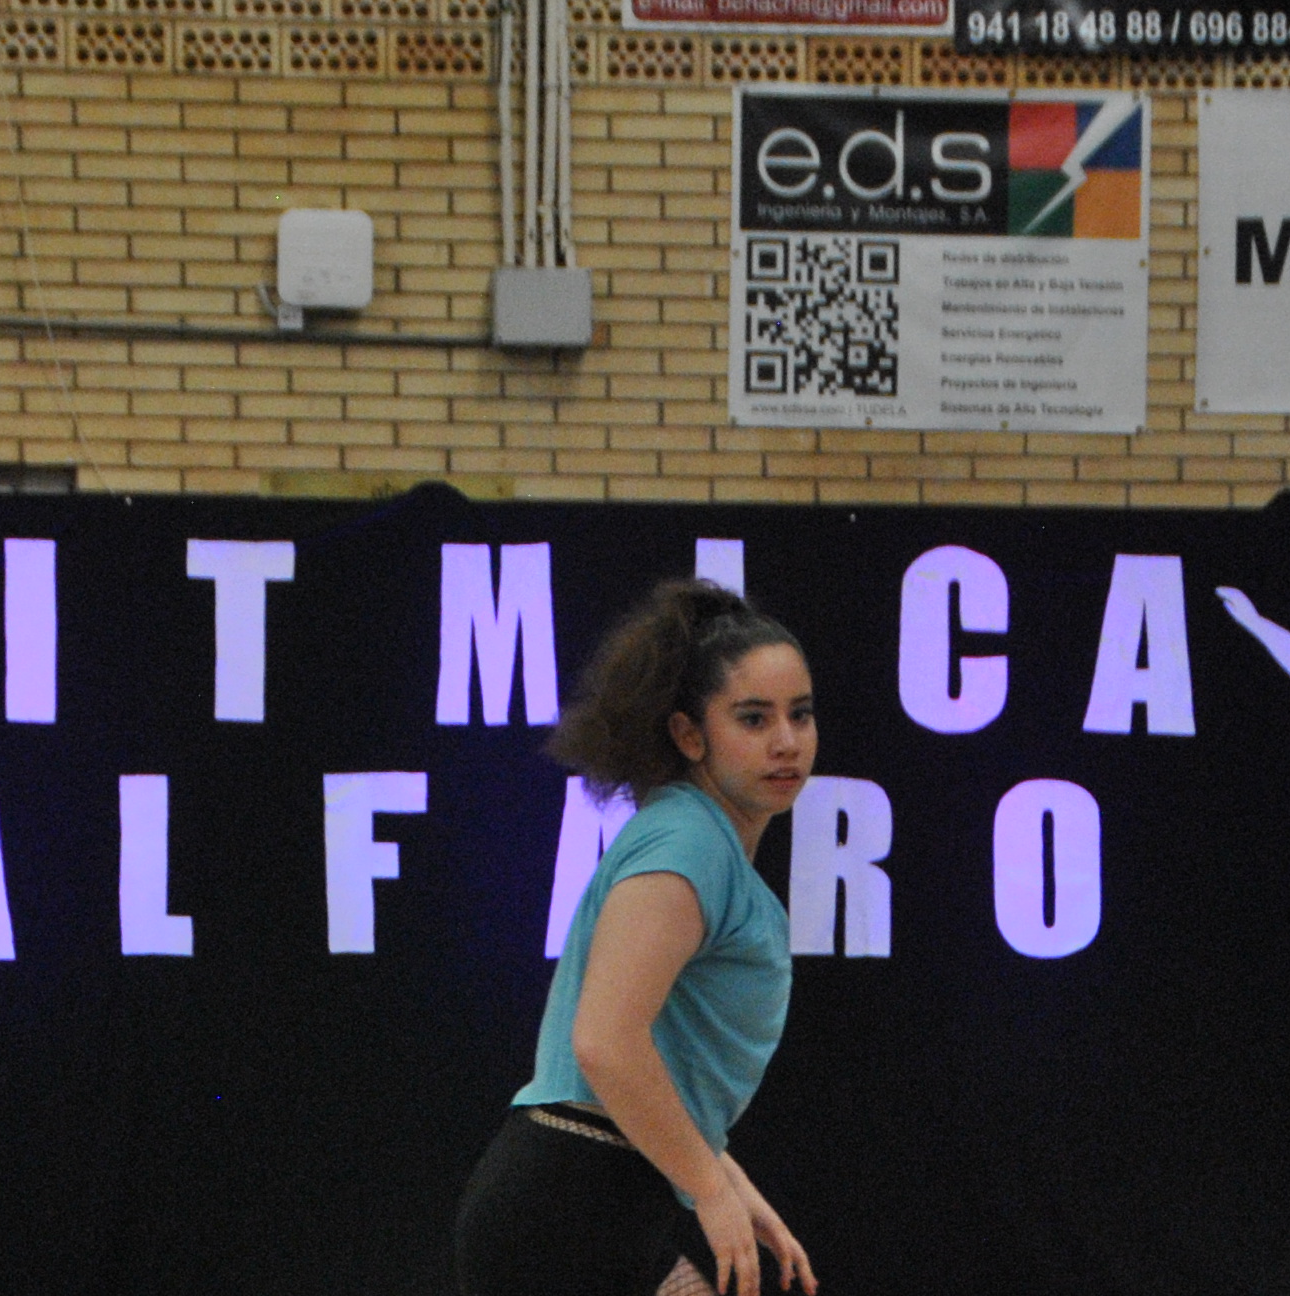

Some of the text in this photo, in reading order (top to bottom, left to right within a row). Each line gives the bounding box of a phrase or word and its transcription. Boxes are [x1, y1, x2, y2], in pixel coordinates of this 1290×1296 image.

[968, 11, 1020, 43] 941
[1035, 11, 1070, 43] 18
[1080, 11, 1116, 44] 48
[1126, 12, 1162, 43] 88
[1190, 11, 1244, 43] 696
[757, 110, 993, 200] e.d.s
